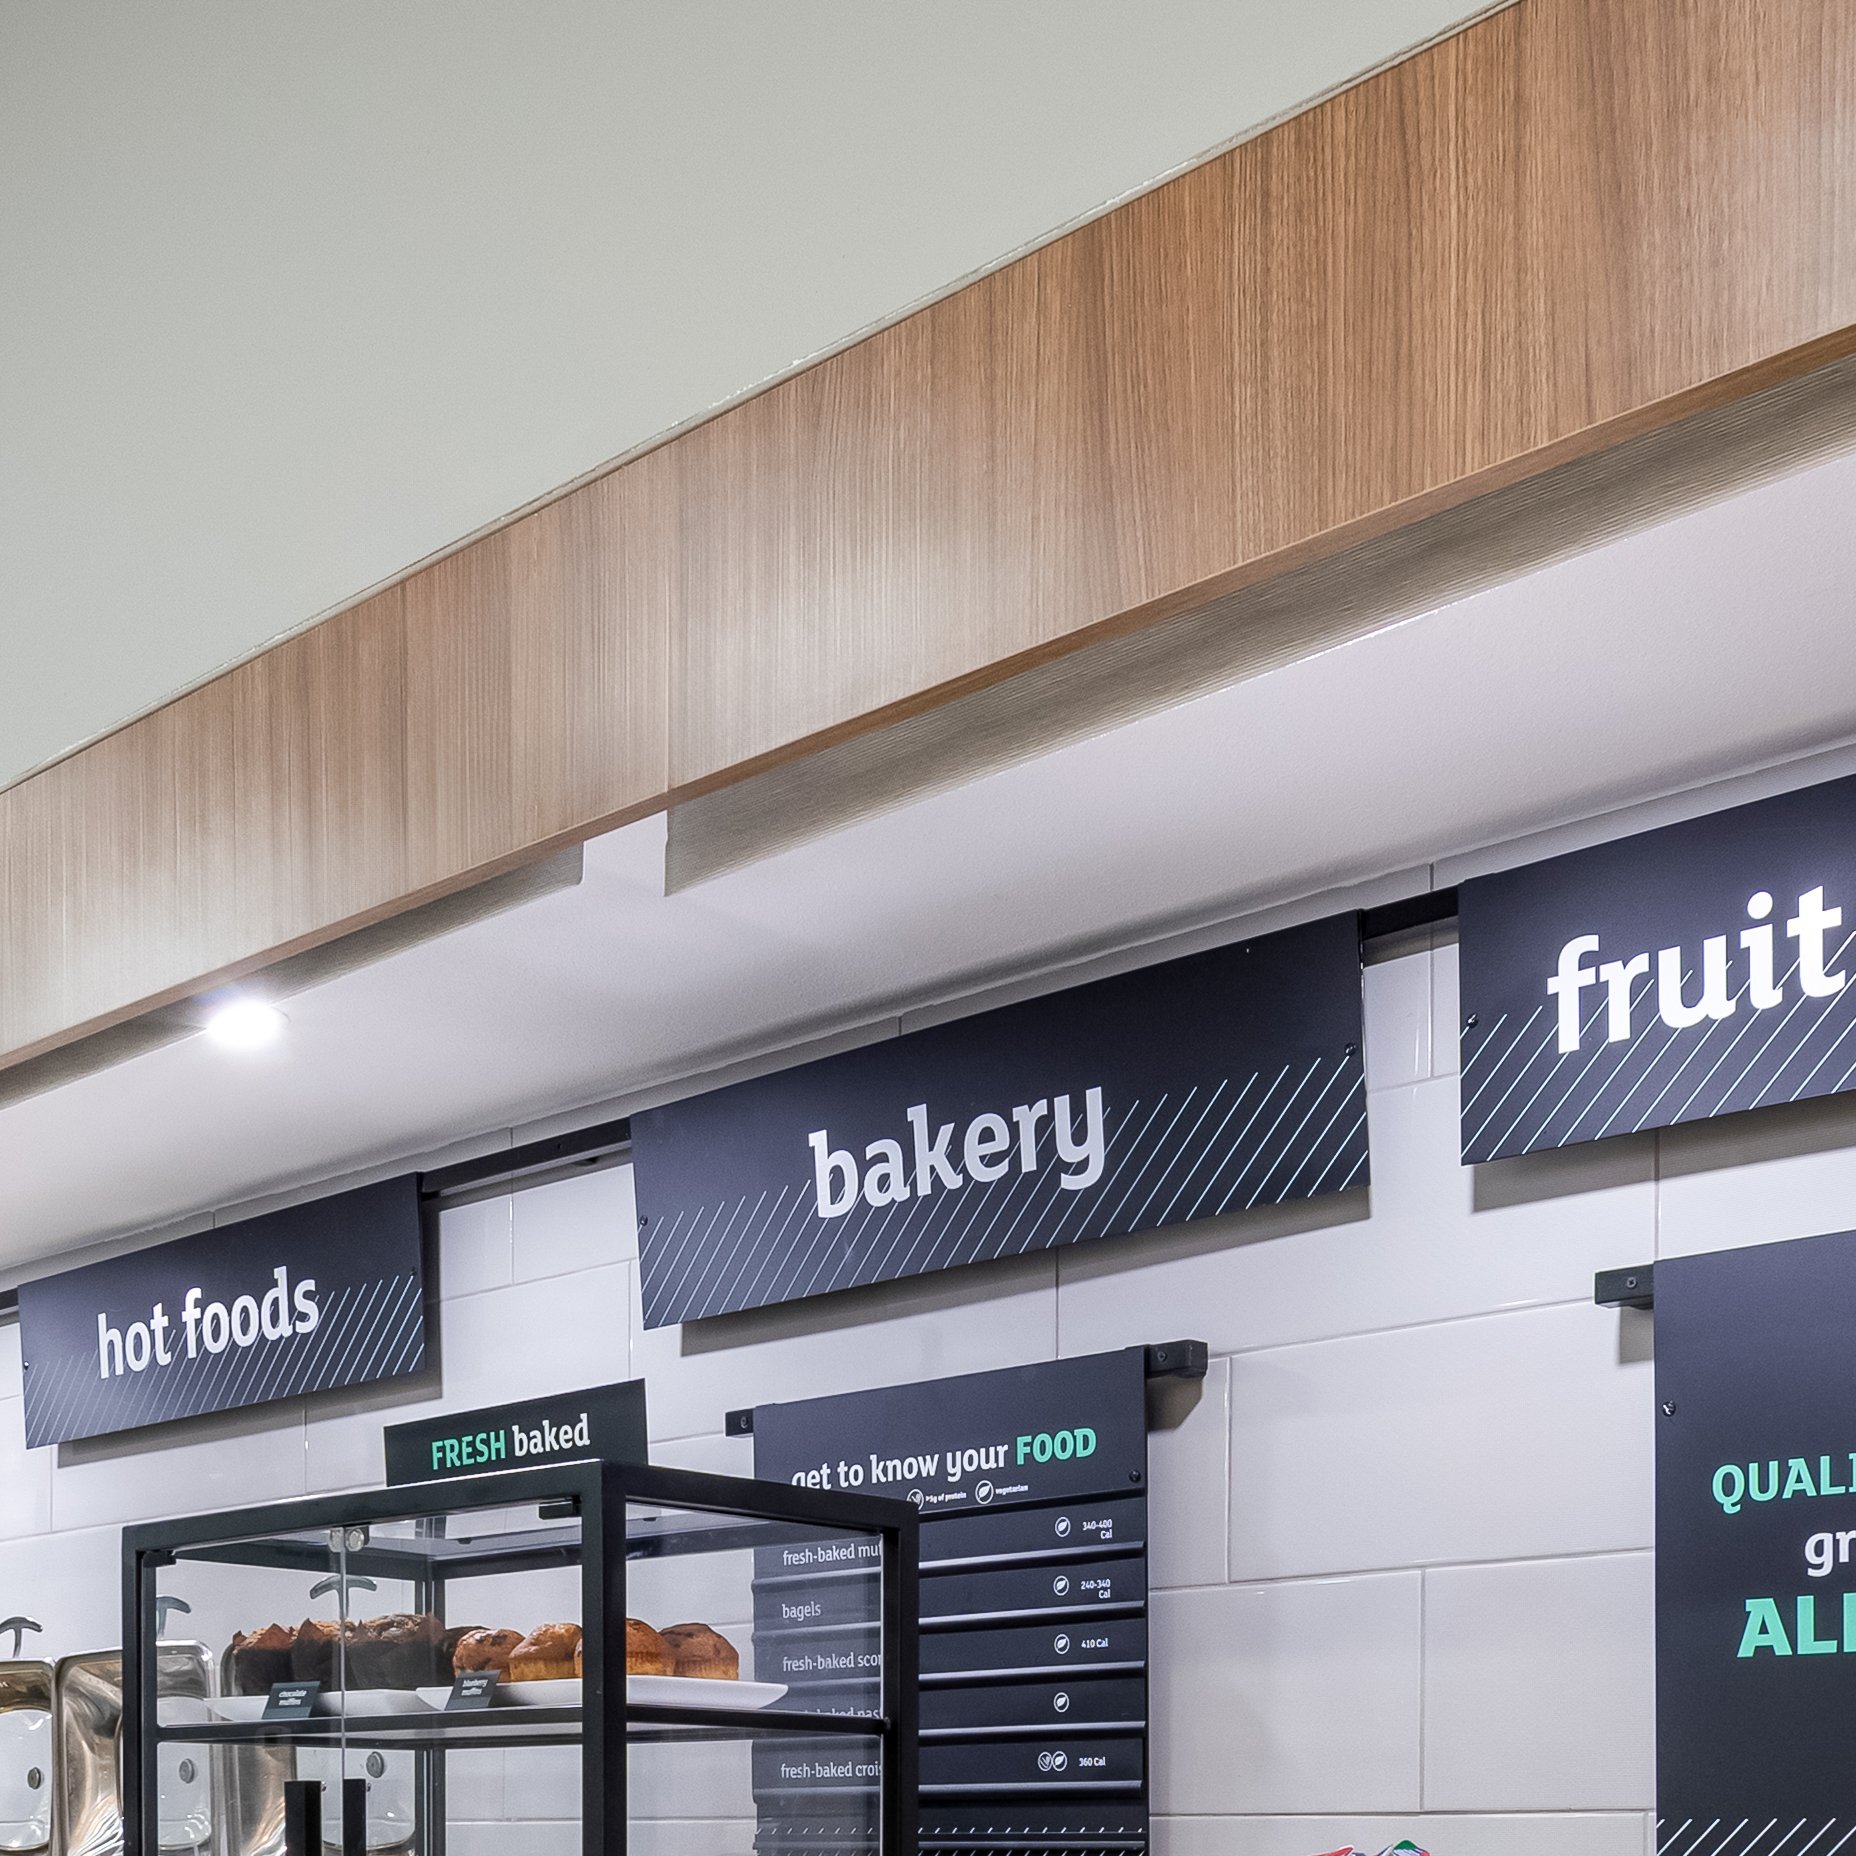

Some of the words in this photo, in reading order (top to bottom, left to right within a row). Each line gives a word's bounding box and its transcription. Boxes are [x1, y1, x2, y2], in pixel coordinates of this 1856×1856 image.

[1548, 886, 1847, 1052] fruit
[810, 1084, 1108, 1222] bakery
[98, 1304, 171, 1379] hot
[182, 1266, 319, 1359] foods
[431, 1429, 507, 1471] FRESH
[513, 1413, 591, 1458] baked
[837, 1461, 864, 1487] to
[870, 1454, 939, 1485] know
[947, 1443, 1009, 1482] your
[1015, 1427, 1097, 1466] FOOD
[1082, 1519, 1112, 1532] 340-400
[1100, 1528, 1113, 1539] Cal
[782, 1543, 855, 1566] fresh-baked
[1080, 1578, 1111, 1590] 240-340
[1098, 1588, 1111, 1599] Cal
[782, 1603, 821, 1622] bagels
[1081, 1639, 1095, 1649] 410
[1096, 1637, 1109, 1648] Cal
[782, 1652, 854, 1672] fresh-baked
[781, 1761, 852, 1778] fresh-baked
[1079, 1757, 1092, 1767] 360
[1093, 1756, 1106, 1766] Cal
